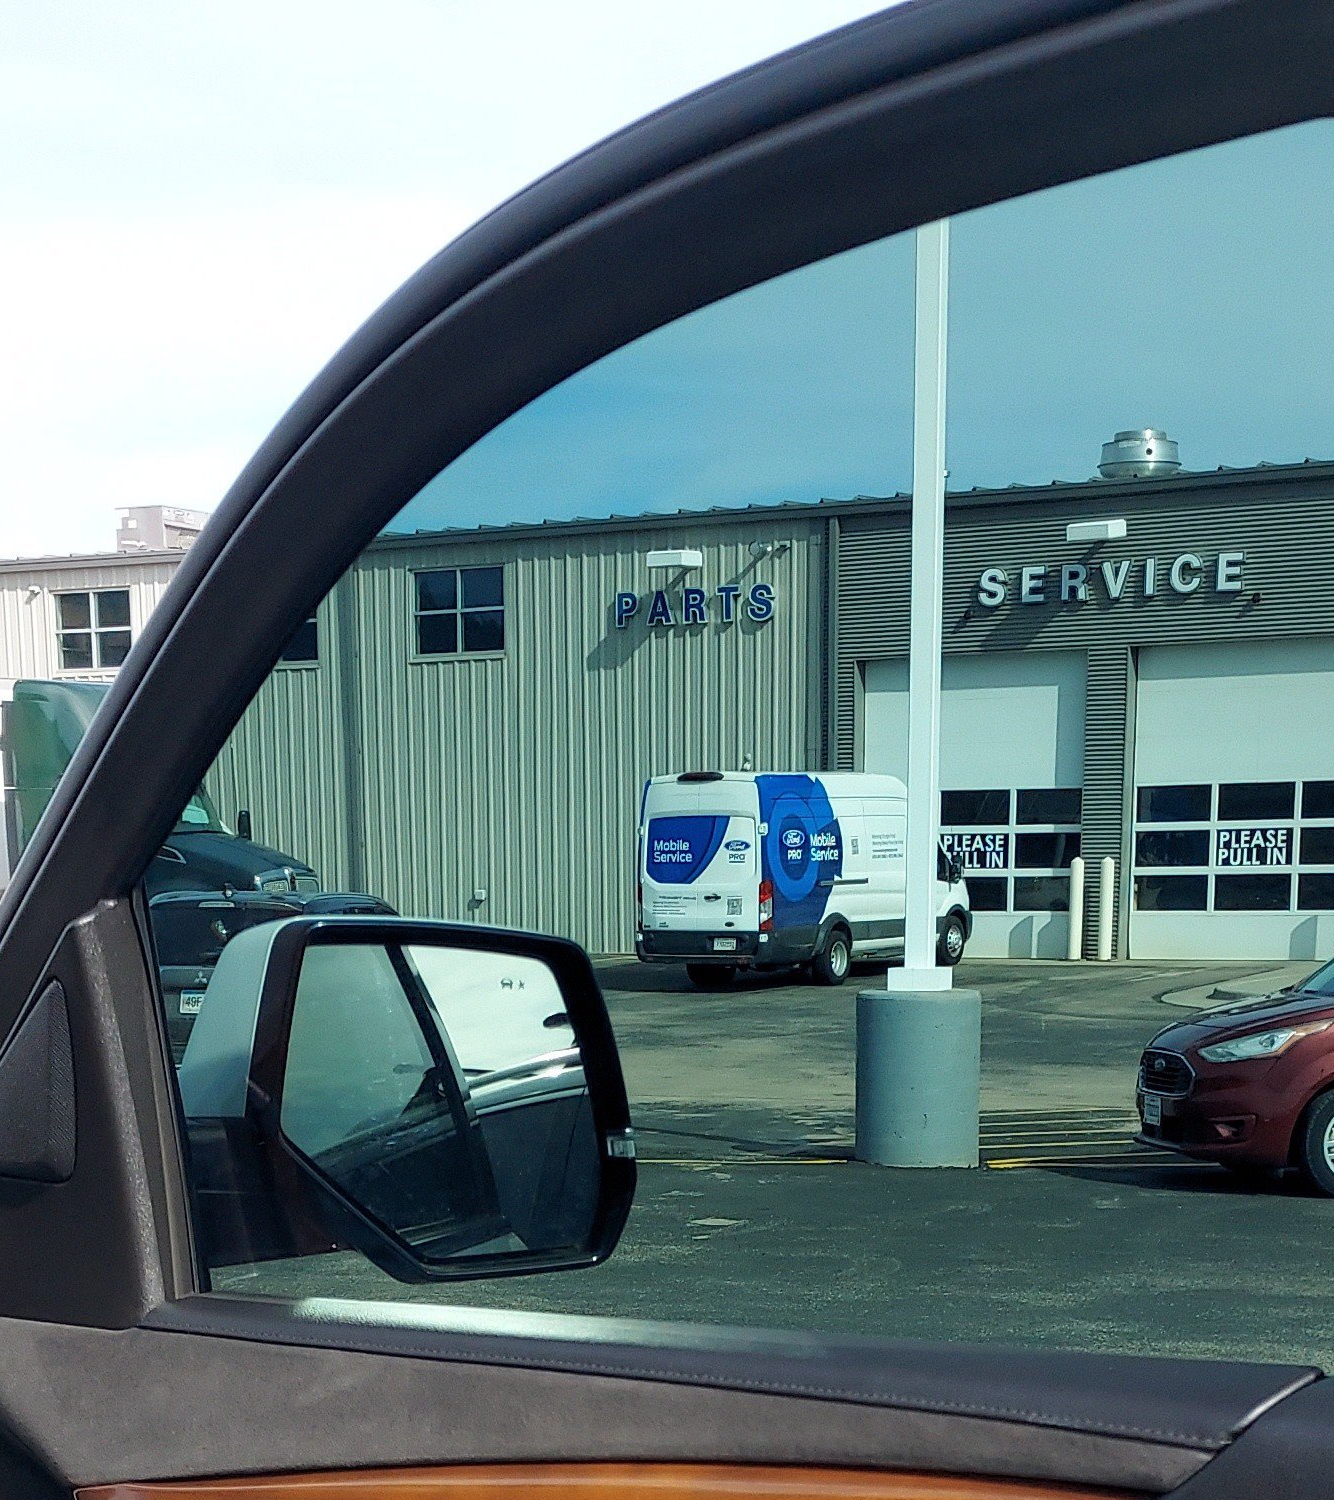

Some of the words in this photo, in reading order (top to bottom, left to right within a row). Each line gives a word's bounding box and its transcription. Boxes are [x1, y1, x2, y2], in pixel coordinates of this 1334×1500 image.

[977, 551, 1245, 606] SERVICE
[615, 584, 775, 628] PARTS
[653, 839, 690, 851] Mobile
[809, 832, 837, 847] Mobile
[943, 834, 1005, 852] PLEASE
[1219, 829, 1288, 849] PLEASE
[653, 851, 693, 863] Service
[728, 853, 746, 861] PRO
[787, 849, 803, 860] PRO
[810, 847, 839, 862] Service
[945, 851, 981, 868] PLL
[985, 851, 1004, 868] IN
[1217, 847, 1261, 866] PULL
[1266, 847, 1287, 865] IN
